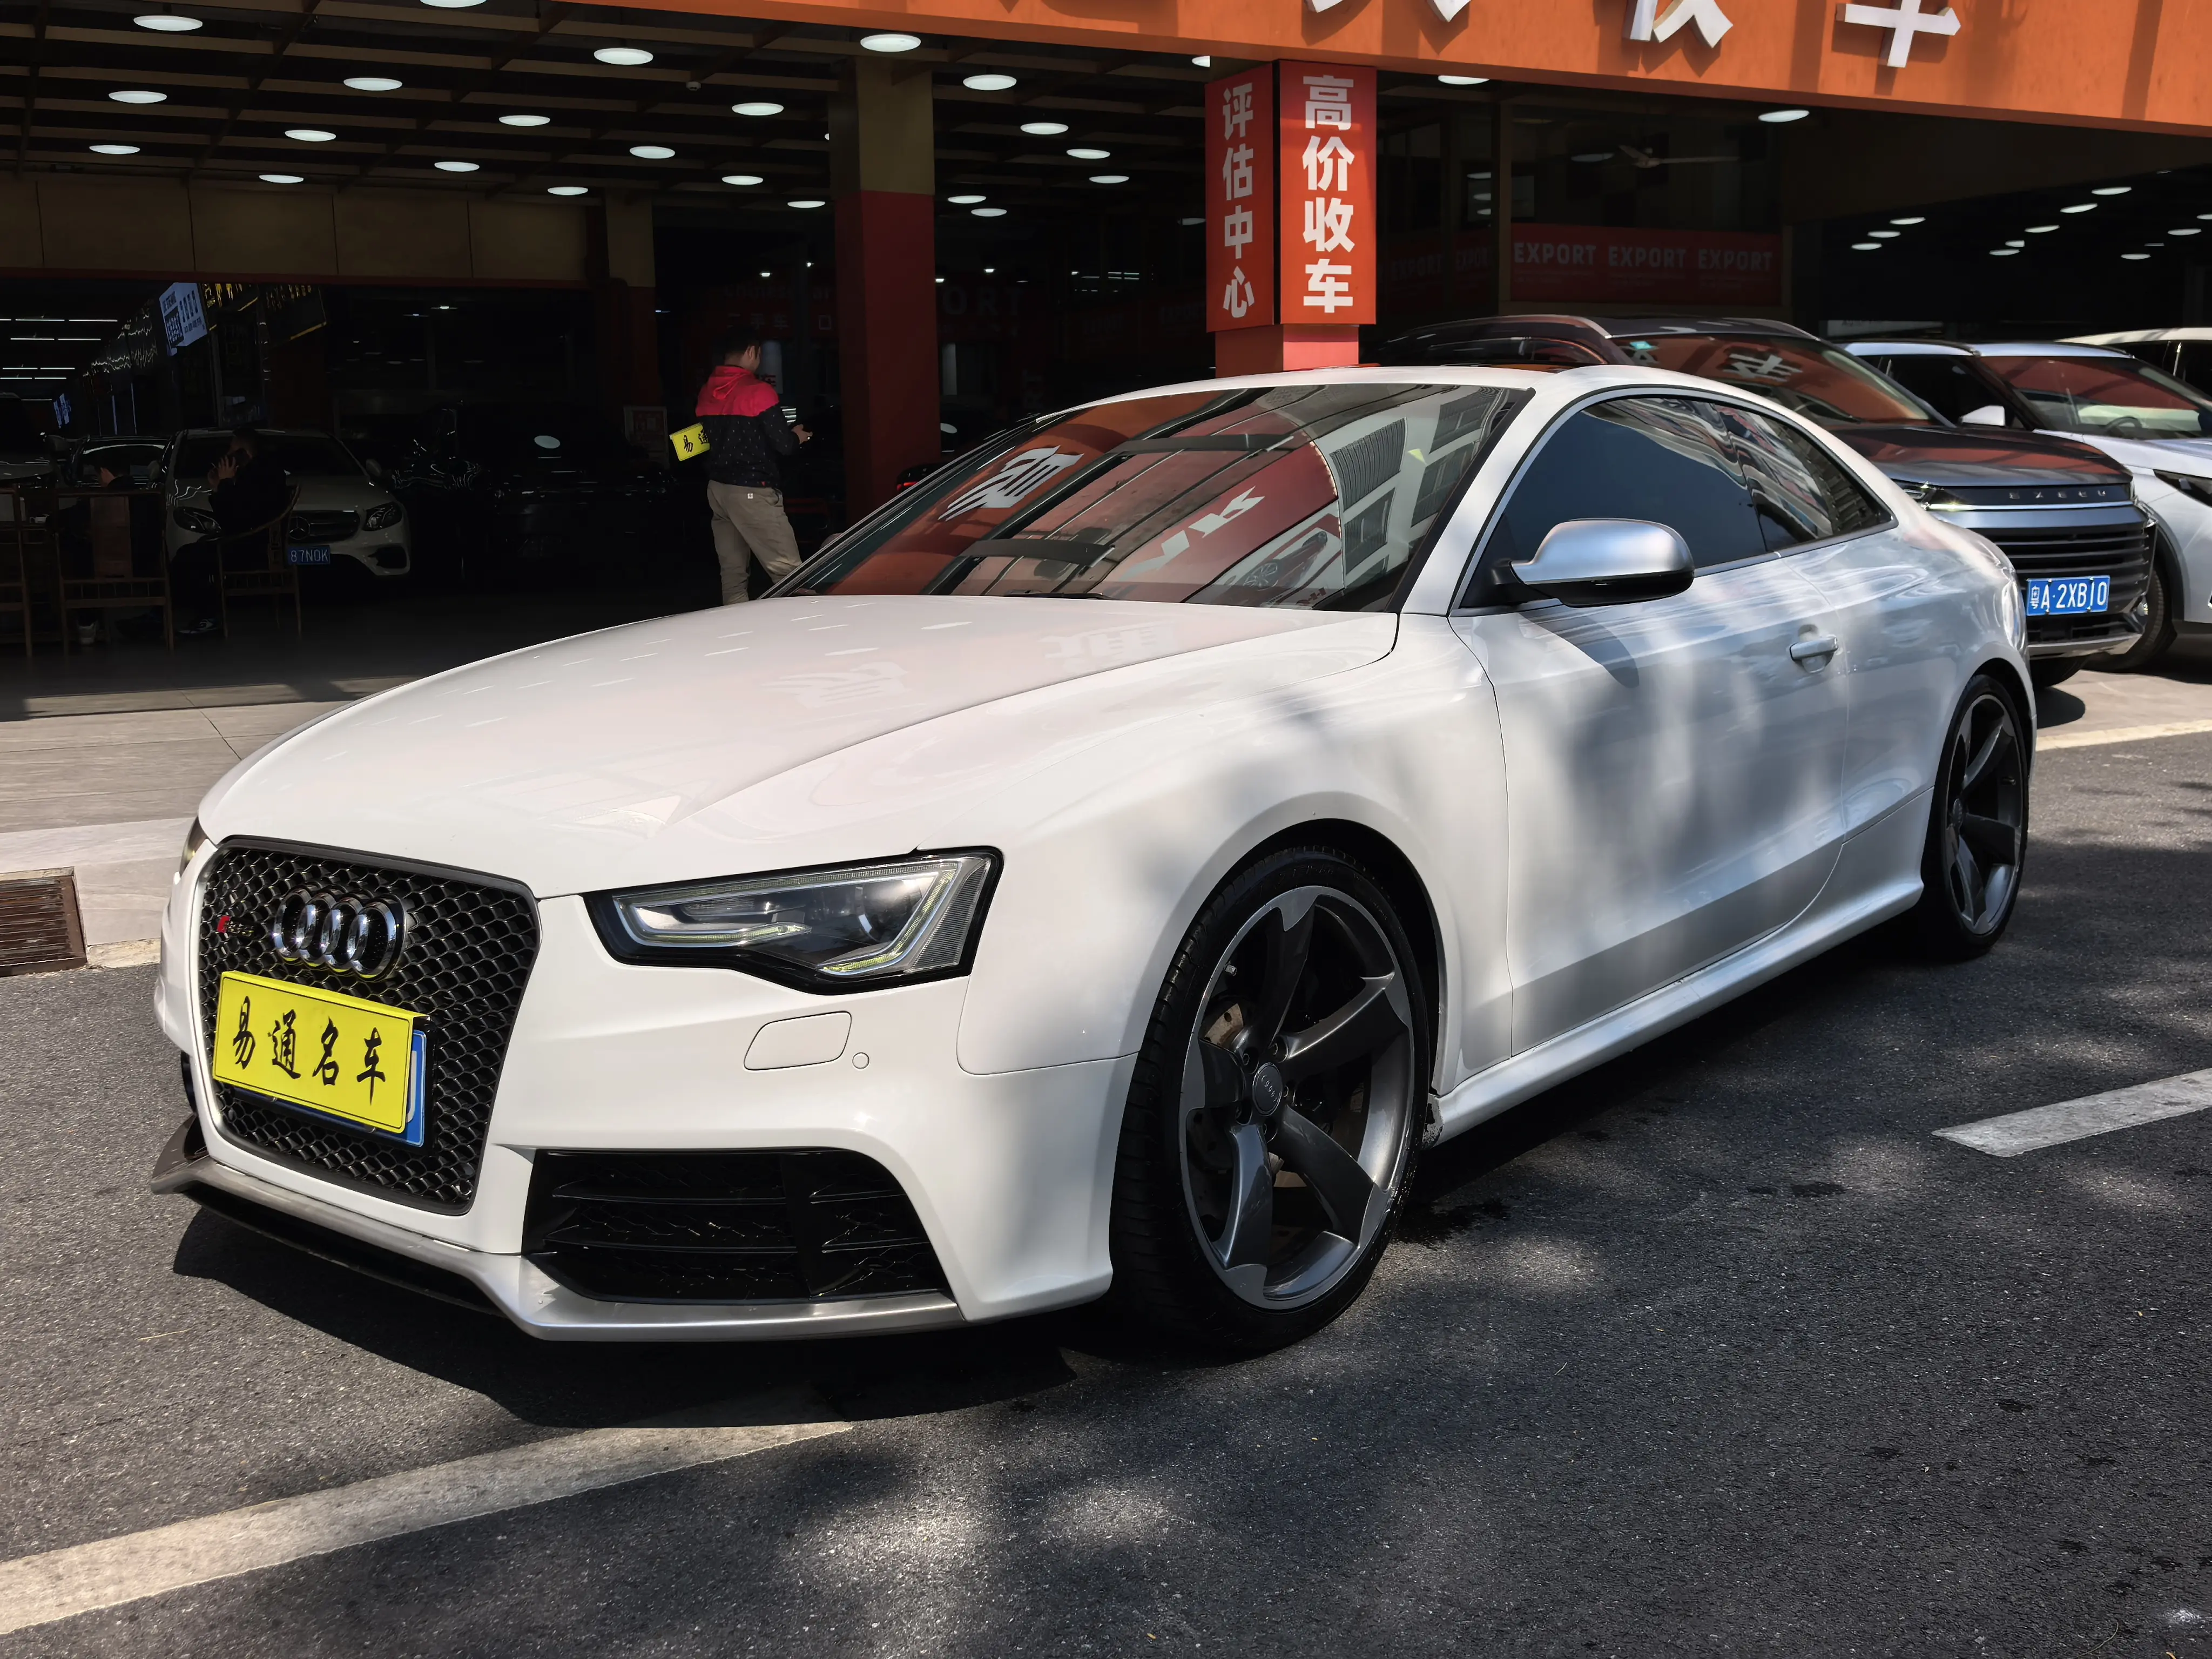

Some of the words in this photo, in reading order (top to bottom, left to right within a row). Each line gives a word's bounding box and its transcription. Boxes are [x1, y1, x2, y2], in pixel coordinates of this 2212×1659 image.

[1222, 82, 1255, 319] 评估中心
[1301, 75, 1355, 314] 高价收车
[1513, 241, 1597, 265] EXPORT
[1608, 245, 1687, 269] EXPORT
[1698, 248, 1773, 272] EXPORT
[812, 286, 832, 300] ar
[942, 284, 1024, 316] ORT
[291, 549, 328, 563] 87NQK
[231, 995, 387, 1106] 易通名车
